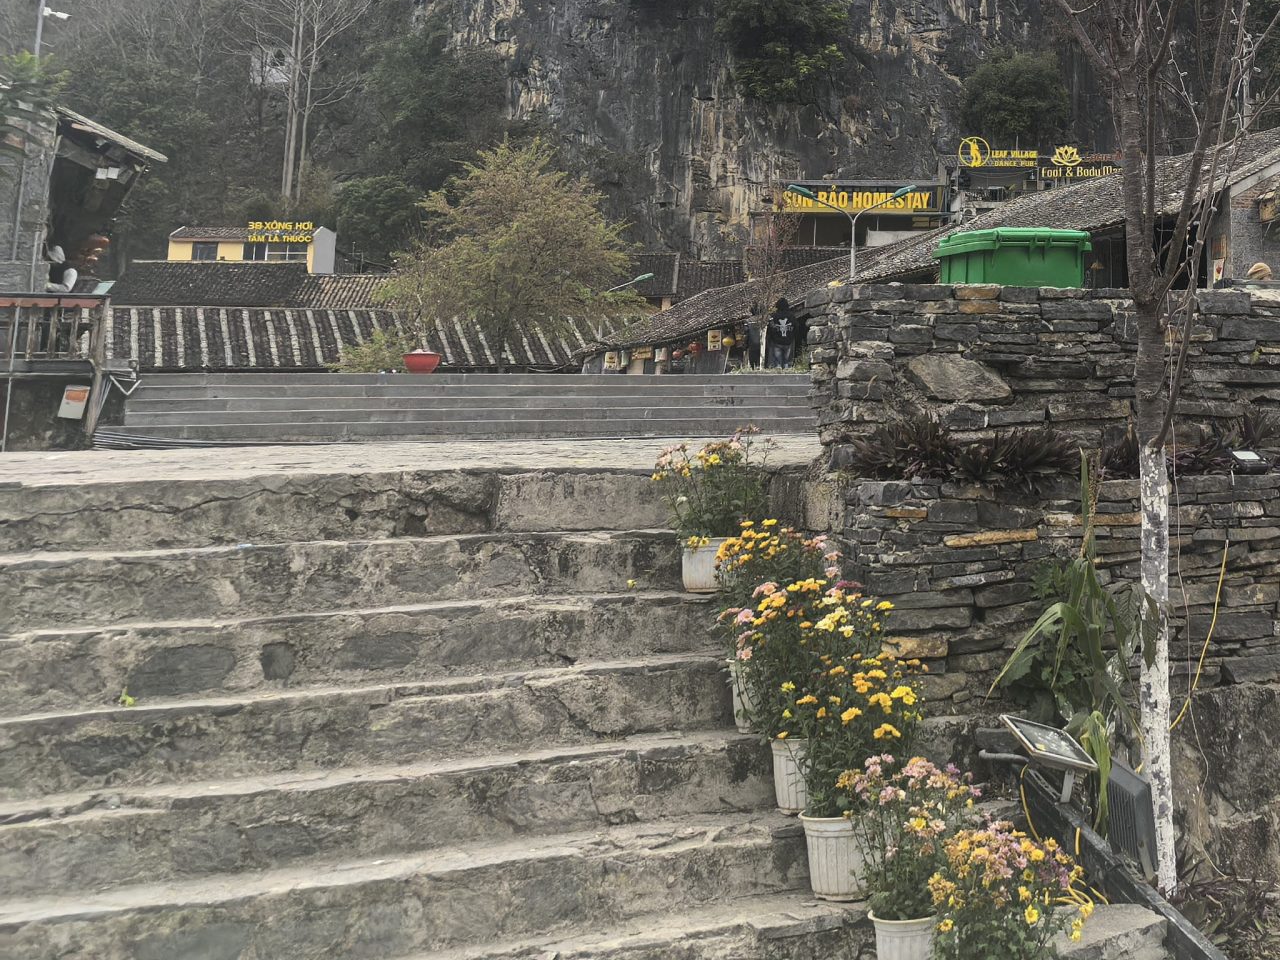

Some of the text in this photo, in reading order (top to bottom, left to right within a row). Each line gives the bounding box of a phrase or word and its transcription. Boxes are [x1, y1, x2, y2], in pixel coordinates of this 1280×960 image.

[991, 150, 1038, 158] LEAF VILLAGE
[1065, 166, 1073, 177] &
[817, 185, 848, 208] BẢO
[852, 191, 931, 209] HOMESTAY
